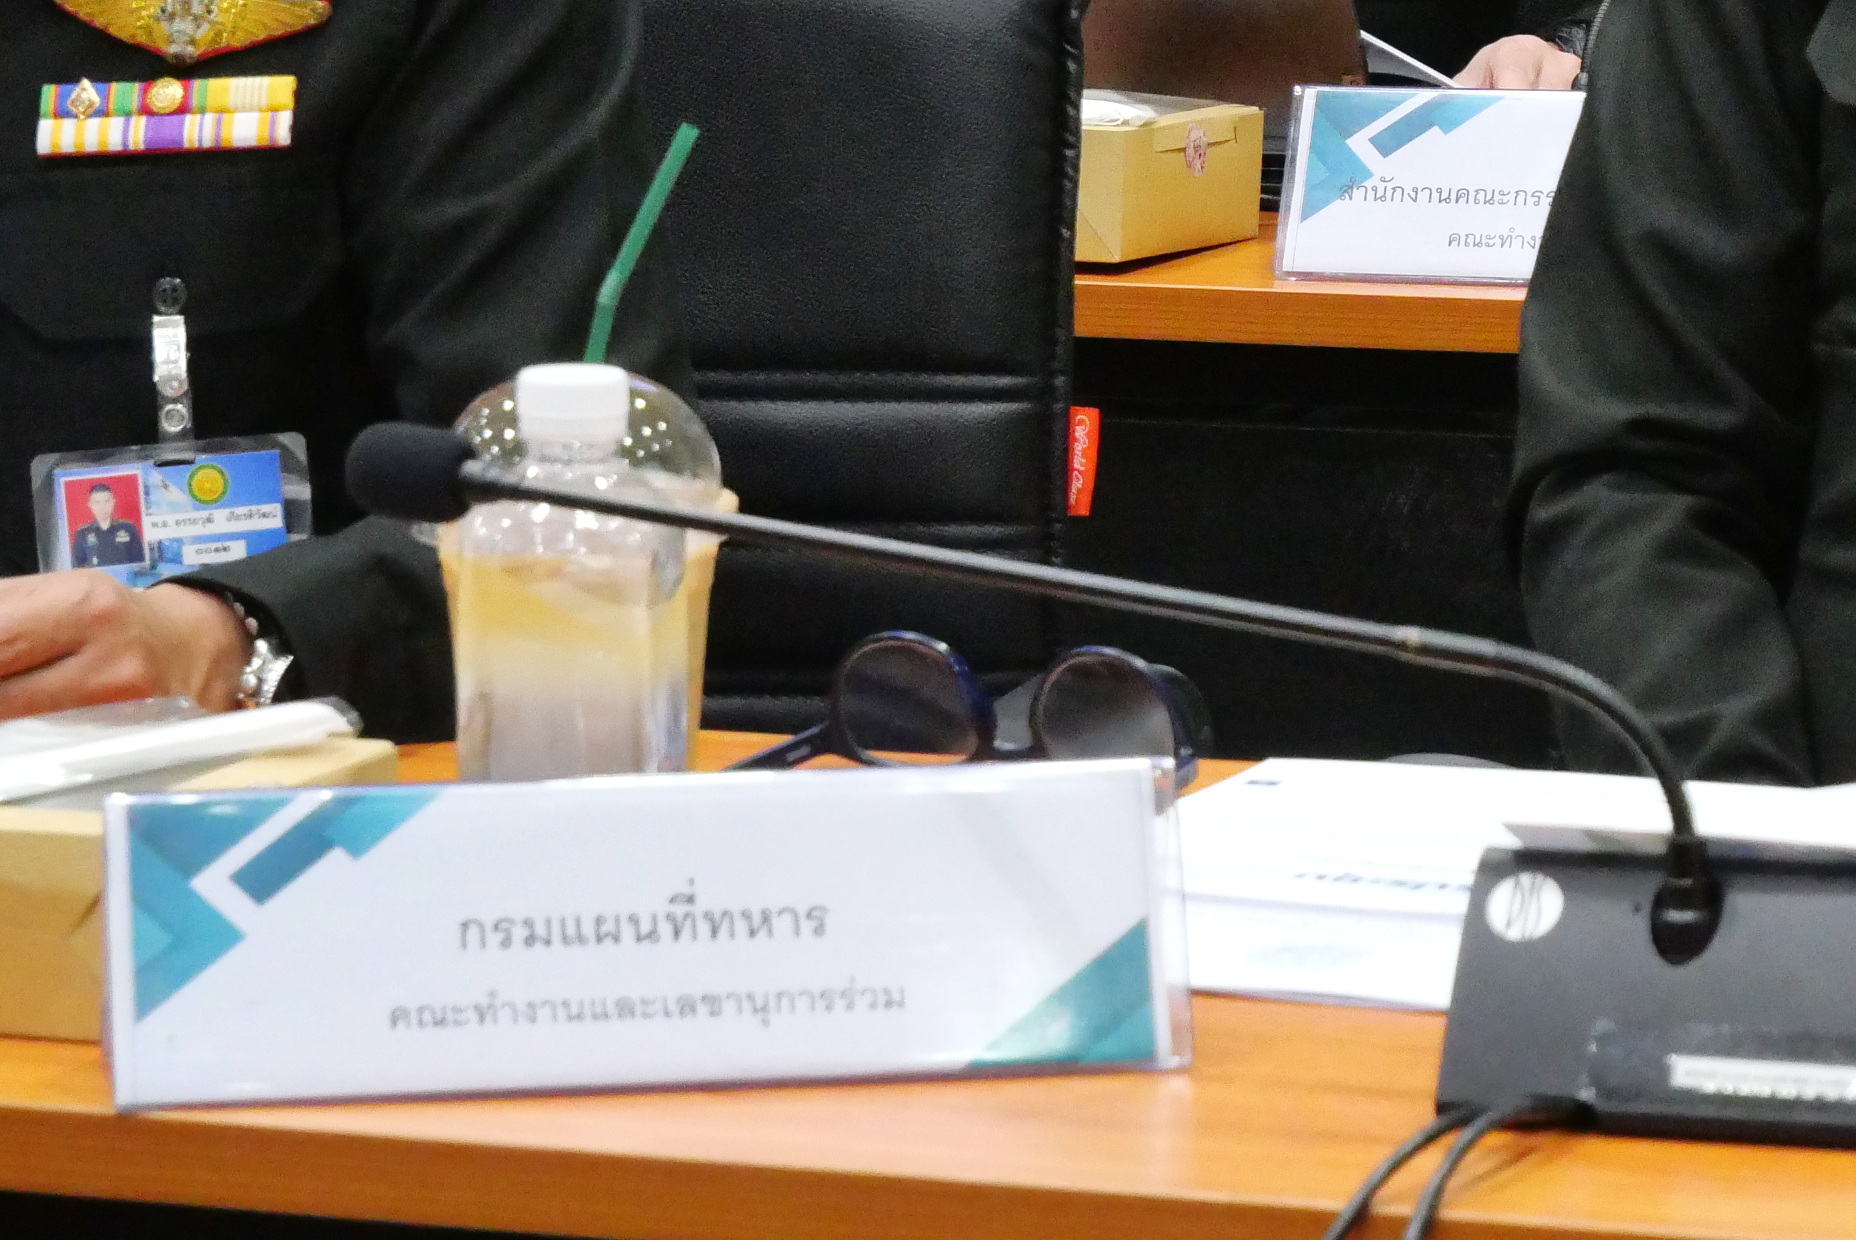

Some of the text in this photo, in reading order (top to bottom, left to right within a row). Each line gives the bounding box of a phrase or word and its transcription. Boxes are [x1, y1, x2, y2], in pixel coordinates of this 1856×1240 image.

[1447, 227, 1544, 250] คณะทำง
[1073, 414, 1090, 470] World
[458, 878, 829, 952] กรมแผนที่ทหาร
[387, 975, 907, 1032] คณะทำงานและเลขานุการร่วม
